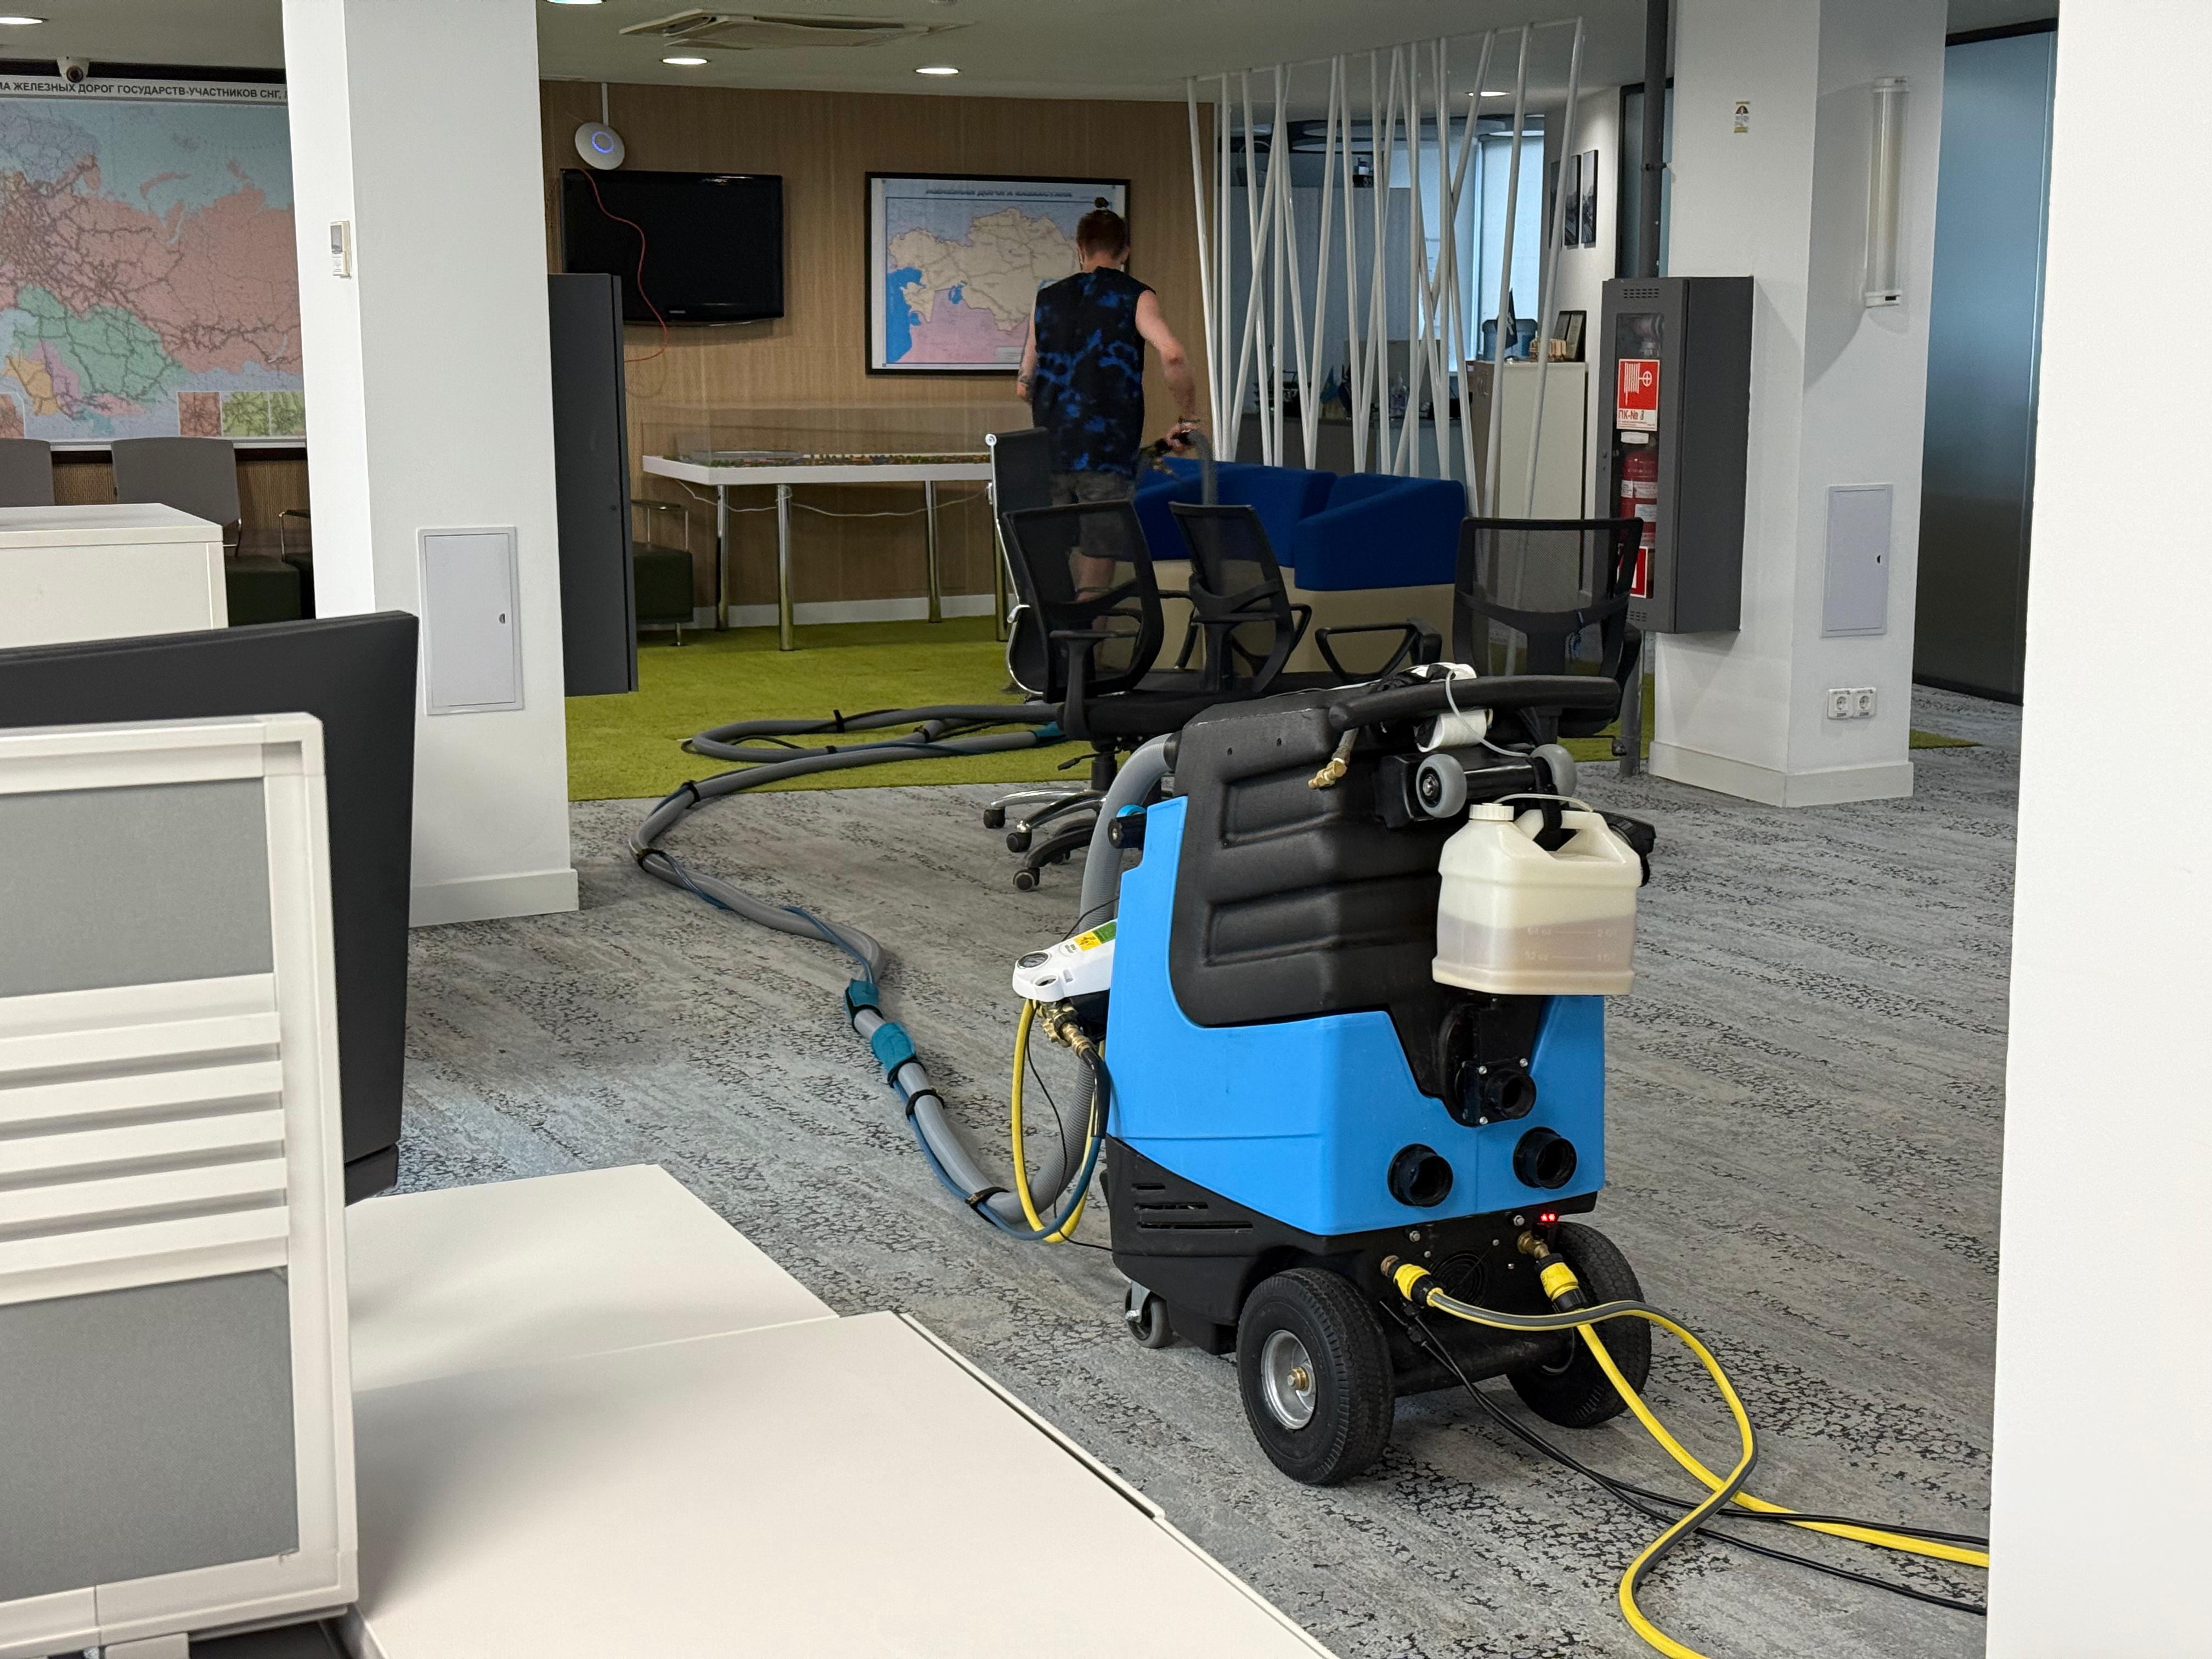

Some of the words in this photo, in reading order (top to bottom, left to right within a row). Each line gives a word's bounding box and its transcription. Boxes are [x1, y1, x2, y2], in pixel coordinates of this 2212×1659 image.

[13, 82, 75, 92] ЖЕЛЕЗНЫХ
[78, 84, 115, 94] ДОРОГ
[118, 85, 257, 98] ГОСУДАРСТВ-УЧАСТНИКОВ
